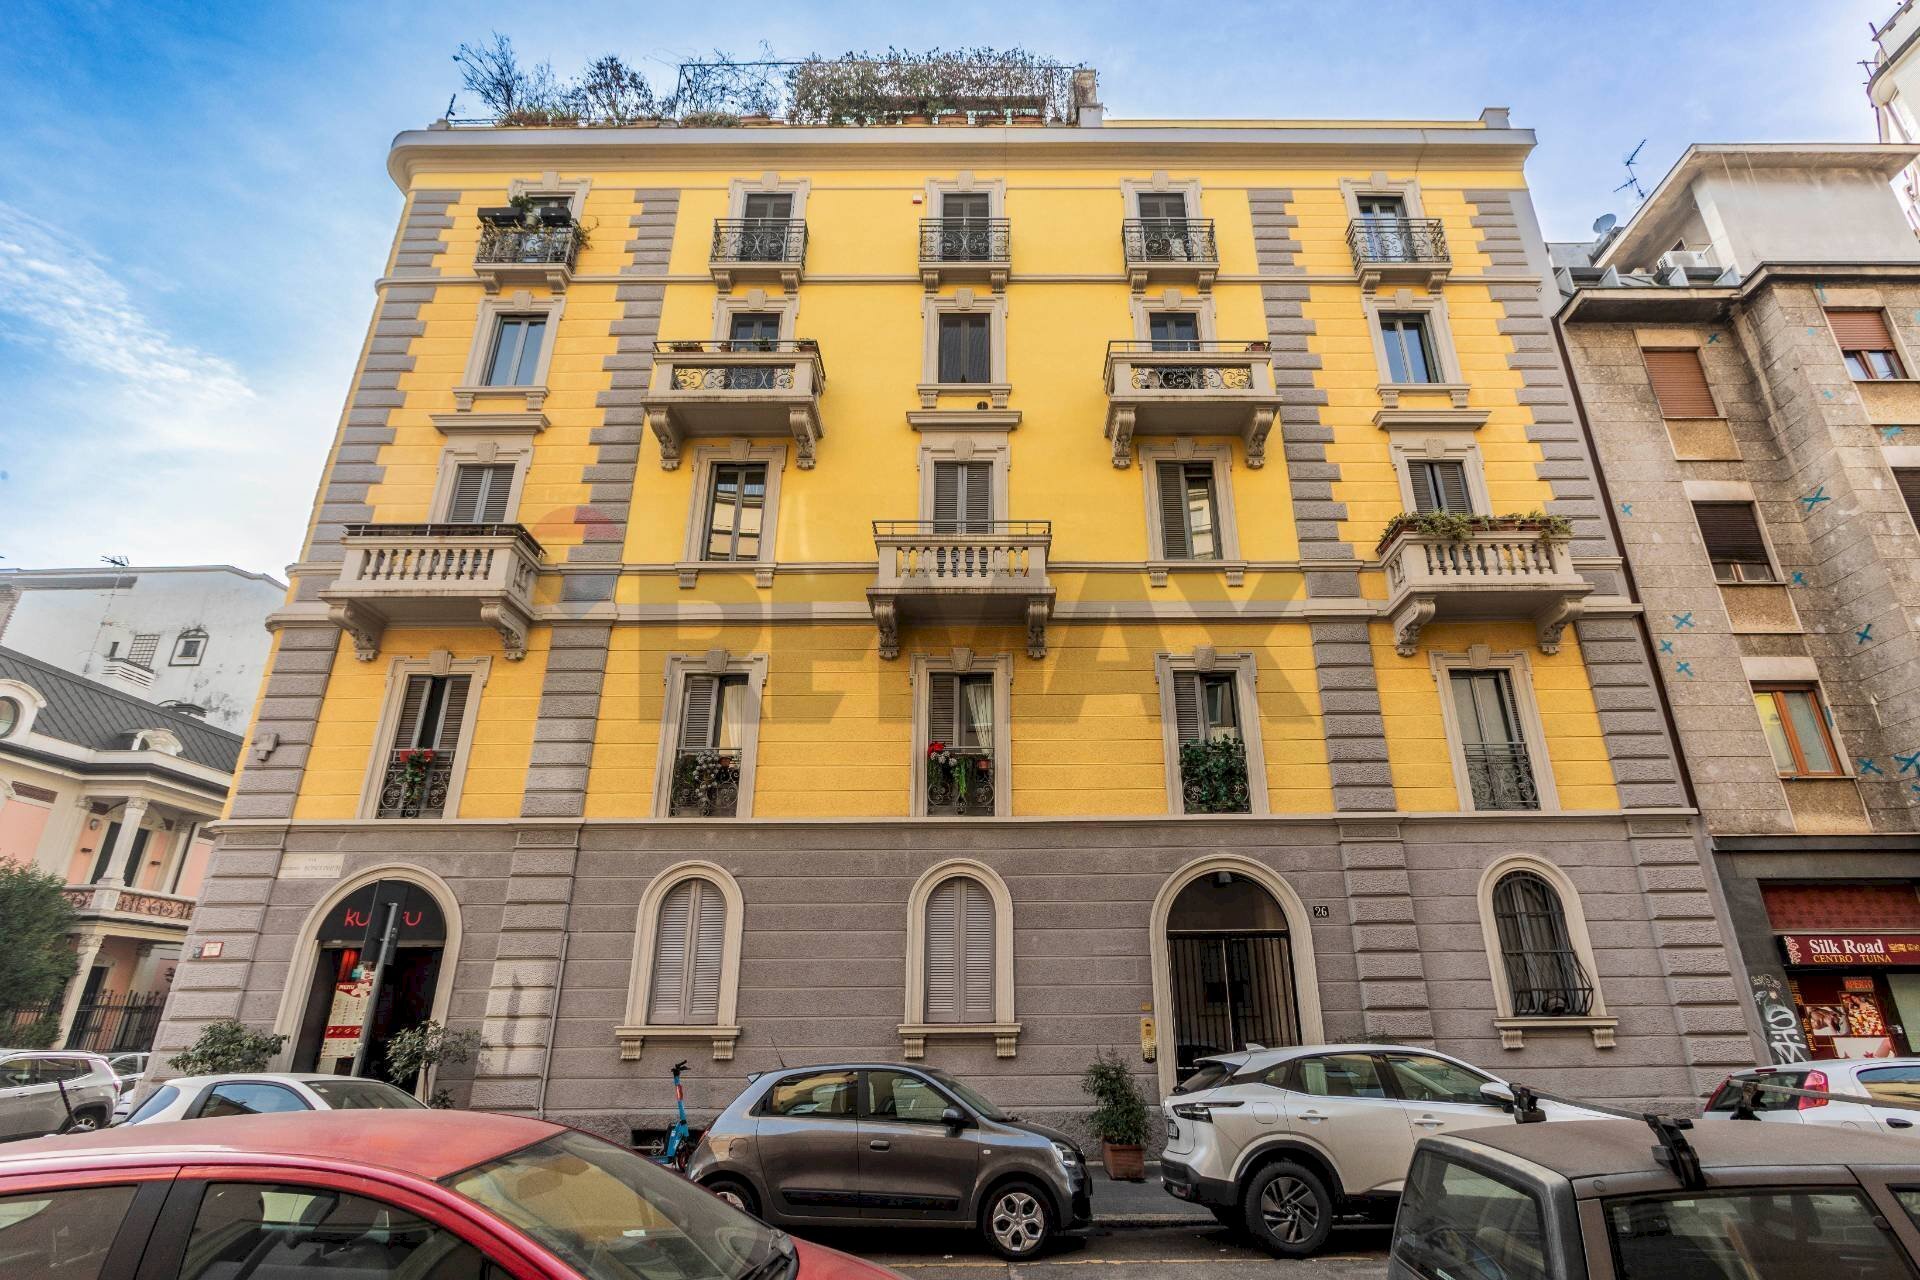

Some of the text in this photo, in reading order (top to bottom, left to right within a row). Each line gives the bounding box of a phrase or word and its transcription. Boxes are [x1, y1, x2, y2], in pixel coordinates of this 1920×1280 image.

[1314, 906, 1328, 917] 26
[1809, 939, 1841, 954] Silk
[1843, 939, 1885, 954] Road
[1813, 954, 1892, 963] CENTRO TUINA
